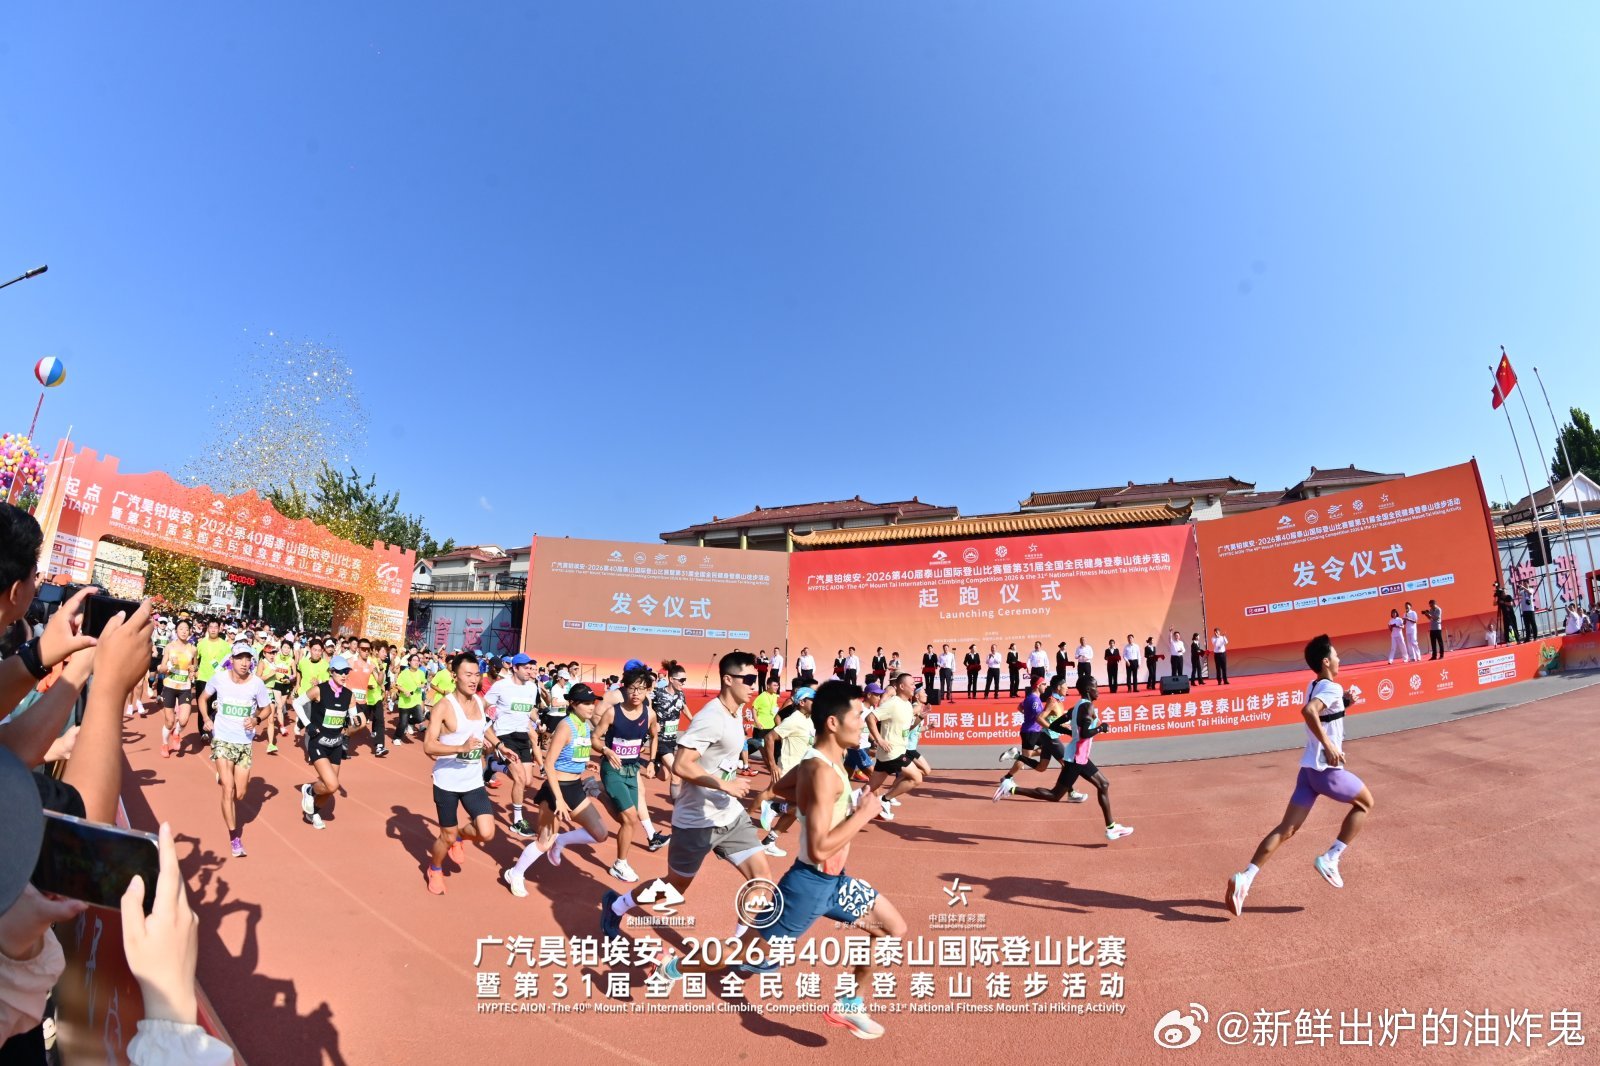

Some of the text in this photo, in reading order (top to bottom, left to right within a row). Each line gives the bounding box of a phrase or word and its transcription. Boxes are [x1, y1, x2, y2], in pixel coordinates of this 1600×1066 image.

[65, 477, 102, 504] 起点
[61, 494, 99, 516] START
[1149, 564, 1171, 572] Activity
[1293, 543, 1407, 588] 发令仪式
[918, 581, 1061, 608] 起跑仪式
[610, 592, 712, 620] 发令仪式
[940, 607, 1051, 619] Launching Ceremony
[226, 706, 249, 716] 0002
[514, 703, 531, 712] 0013
[920, 712, 1025, 728] 国际登山比赛
[1134, 722, 1165, 732] Fitness
[1167, 721, 1194, 729] Mount
[1211, 716, 1239, 726] Hiking
[1240, 712, 1271, 723] Activity
[924, 730, 965, 740] Climbing
[616, 746, 638, 755] 8028
